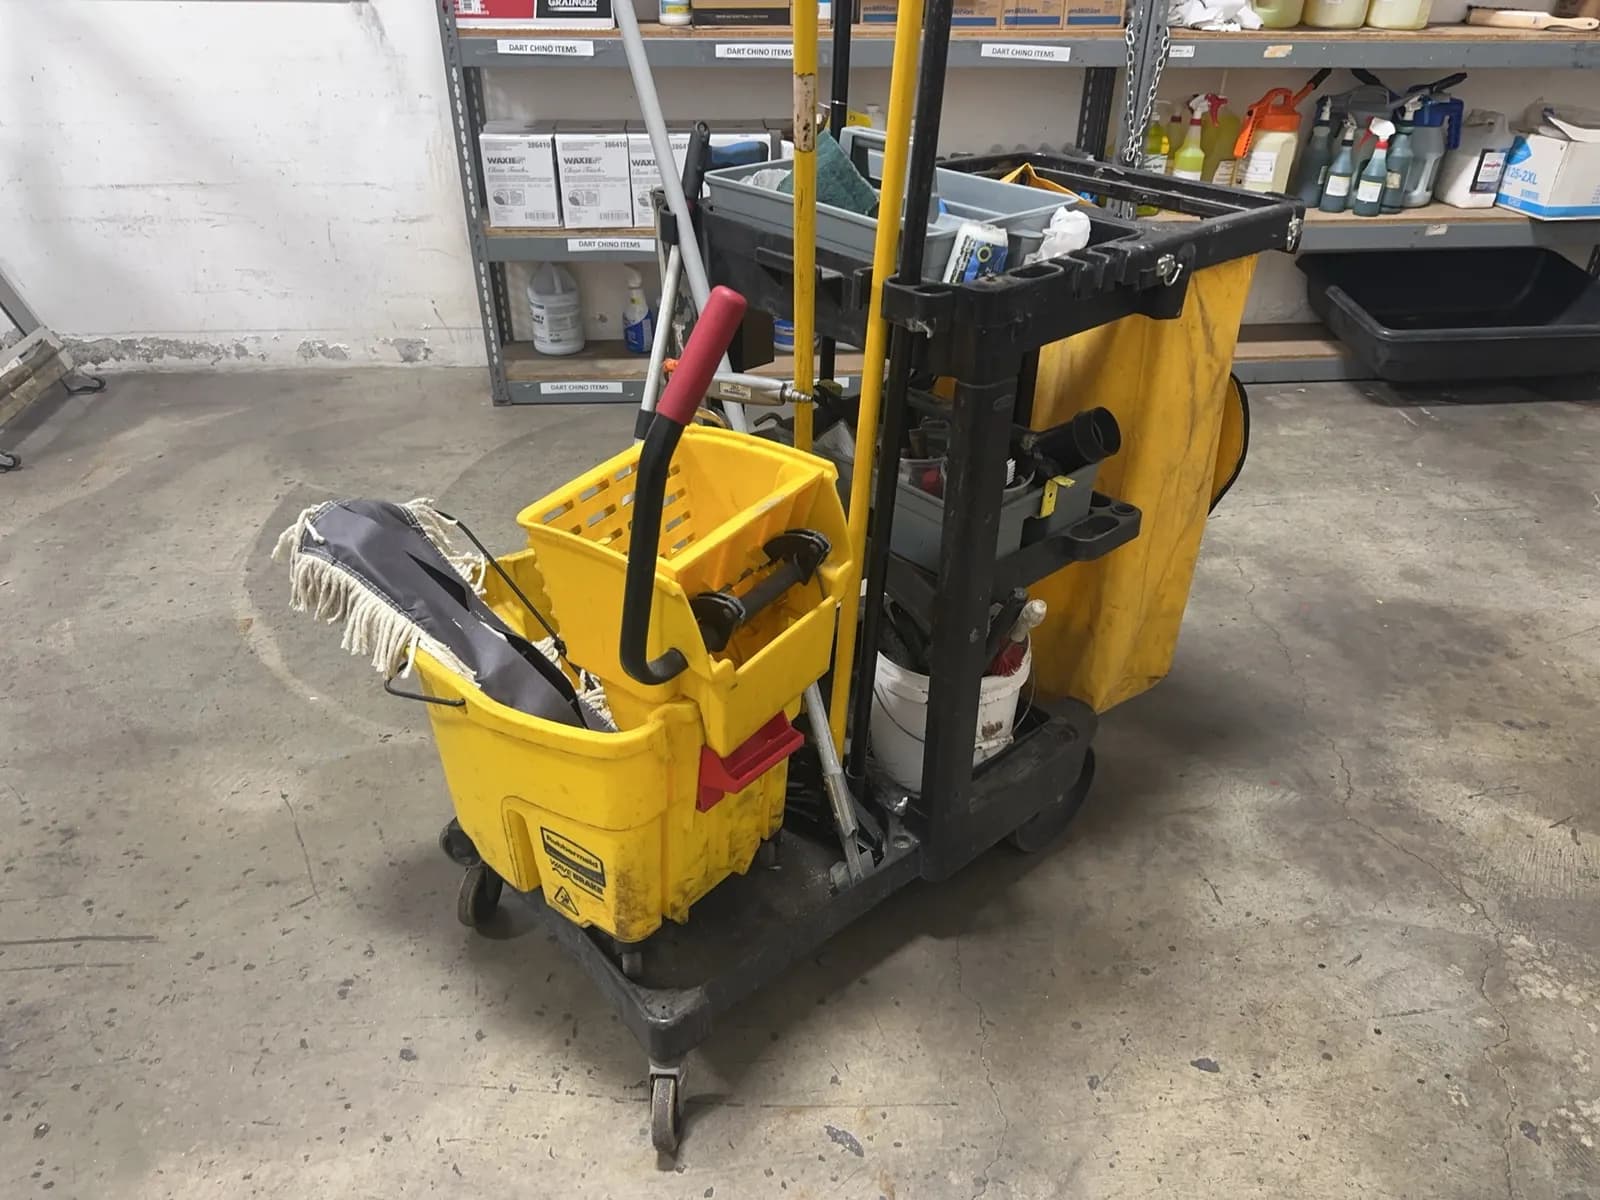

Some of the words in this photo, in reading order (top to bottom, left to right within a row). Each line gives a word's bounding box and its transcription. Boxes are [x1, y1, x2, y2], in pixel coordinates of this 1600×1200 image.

[508, 44, 528, 52] DART
[529, 44, 554, 53] CHINO
[554, 45, 577, 54] ITEMS
[726, 47, 746, 56] DART
[747, 48, 770, 56] CHINO
[770, 49, 793, 57] ITEMS
[991, 47, 1010, 55] DART
[1010, 48, 1033, 57] CHINO
[1033, 50, 1055, 58] ITEMS
[487, 156, 517, 165] WAXIE
[563, 156, 593, 165] WAXIE
[578, 240, 596, 248] DART
[597, 240, 619, 248] CHINO
[620, 240, 641, 249] ITEMS
[550, 383, 567, 391] DART
[568, 383, 589, 391] CHINO
[589, 383, 609, 391] ITEMS
[546, 834, 599, 868] Rubbermaid
